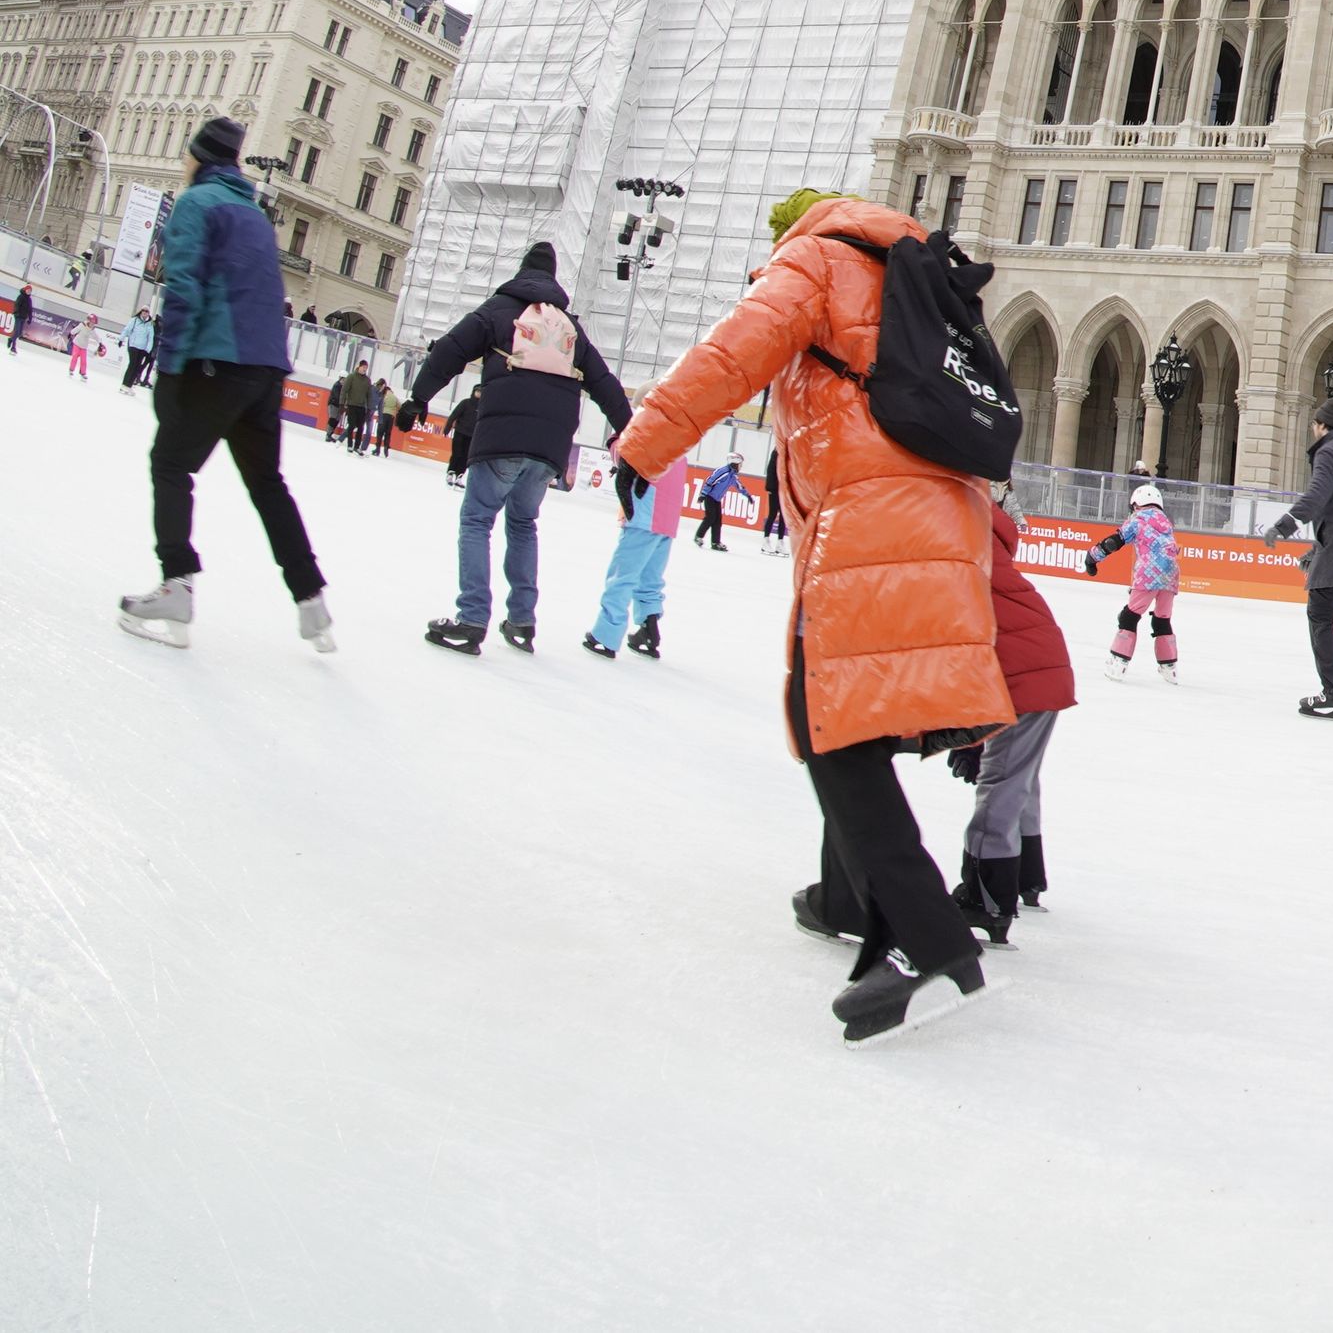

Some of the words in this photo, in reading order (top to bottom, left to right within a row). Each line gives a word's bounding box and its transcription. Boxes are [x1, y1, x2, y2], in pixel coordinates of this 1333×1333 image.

[1031, 526, 1055, 539] zum
[1058, 527, 1092, 542] leben.
[1207, 549, 1225, 560] IST
[1229, 552, 1254, 563] DAS
